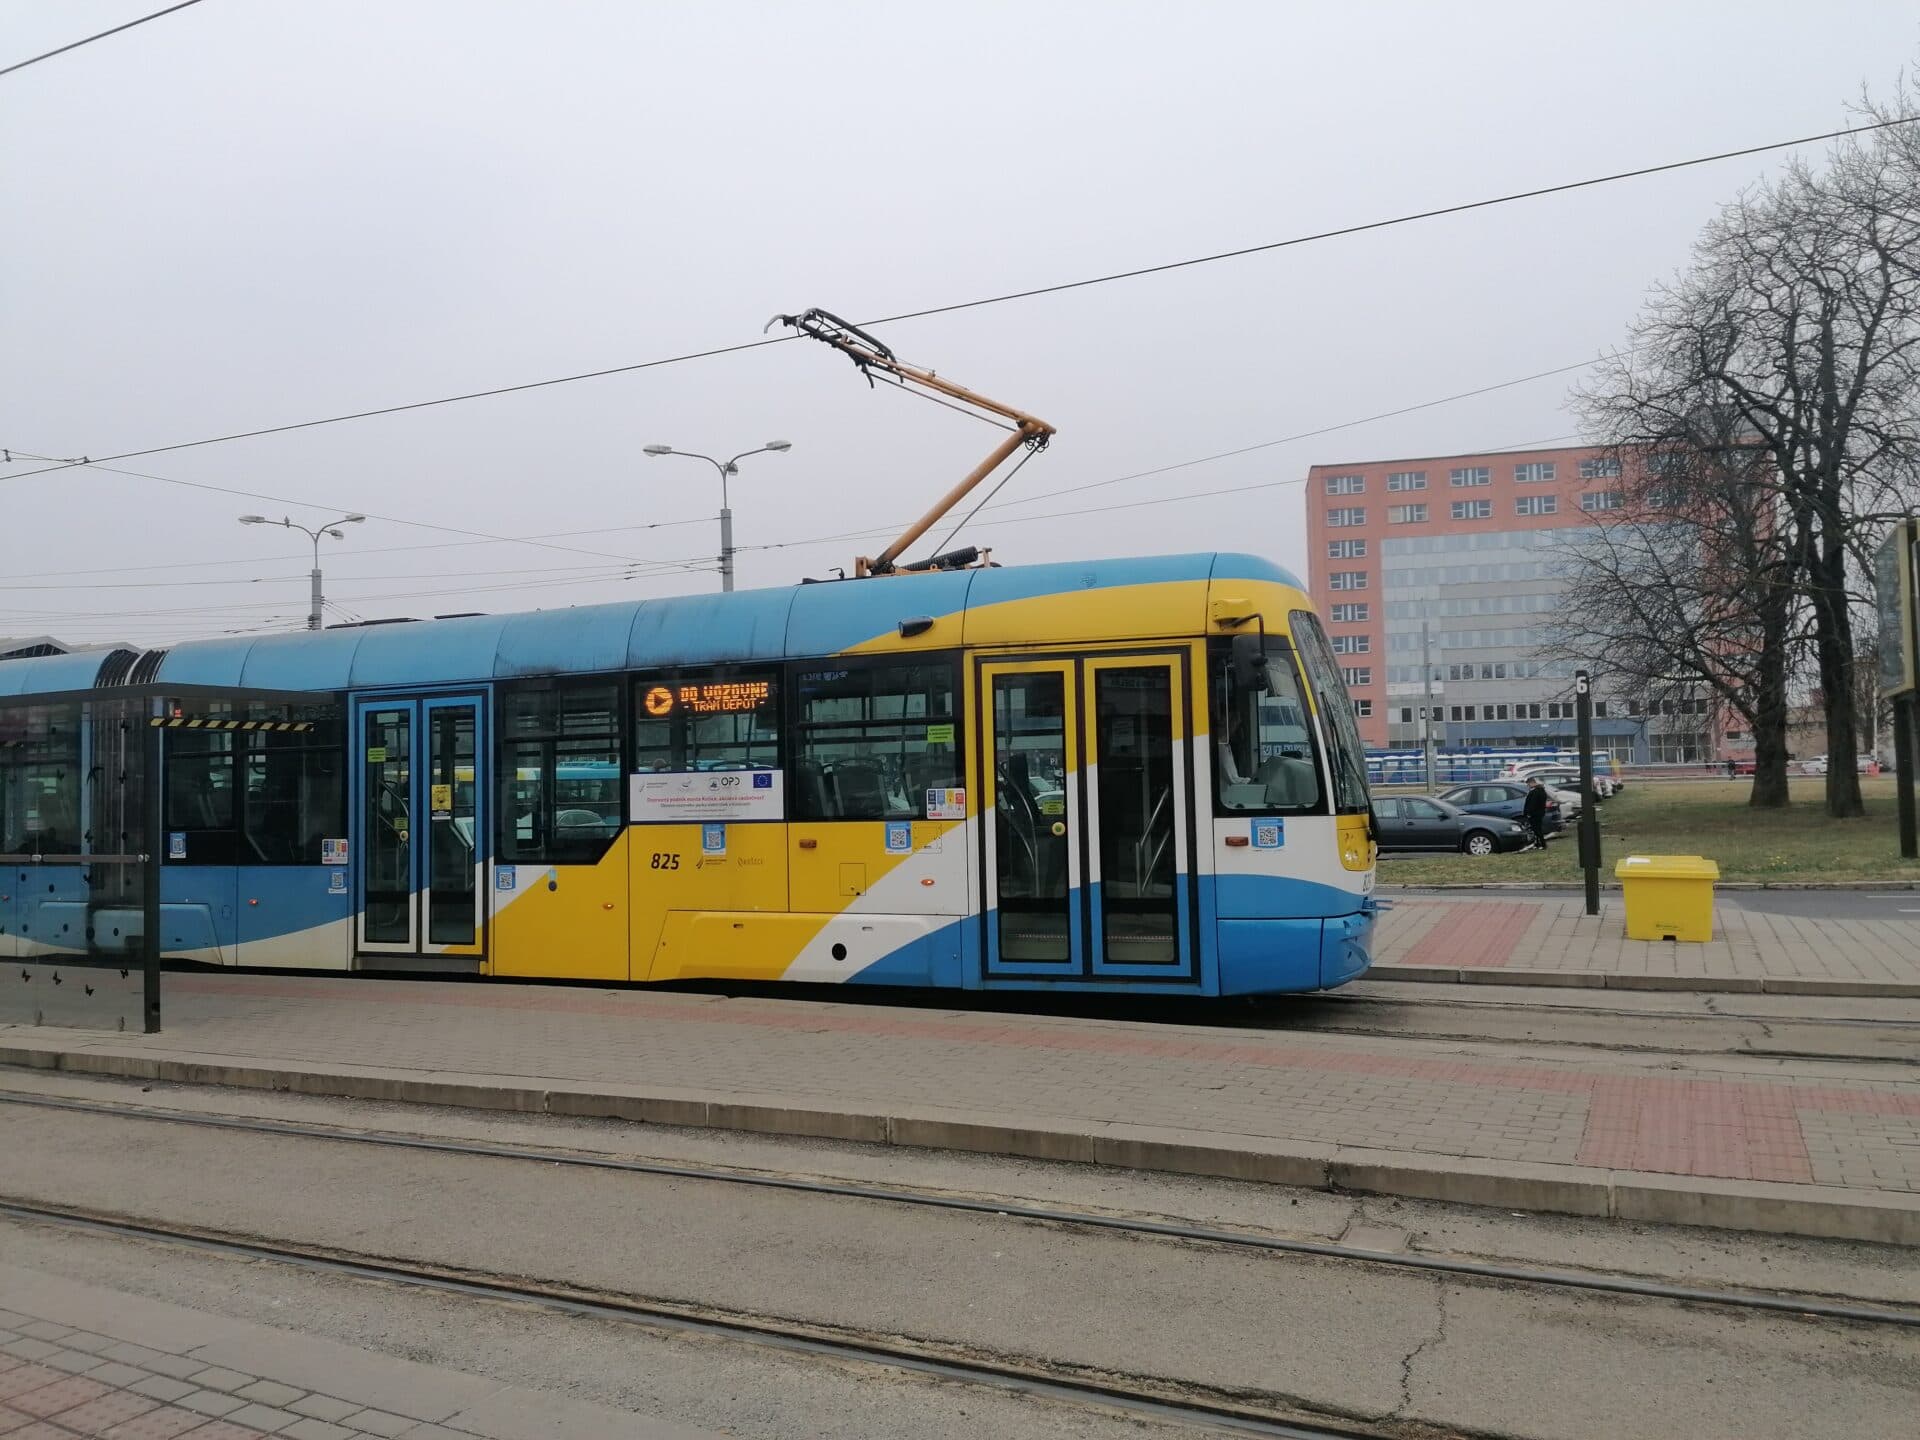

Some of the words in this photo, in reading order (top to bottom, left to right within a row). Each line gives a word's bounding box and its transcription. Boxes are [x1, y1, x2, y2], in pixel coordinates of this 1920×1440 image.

[1576, 676, 1588, 694] 6
[694, 700, 720, 712] TRAM
[723, 698, 758, 711] DEPOT
[651, 853, 681, 870] 825
